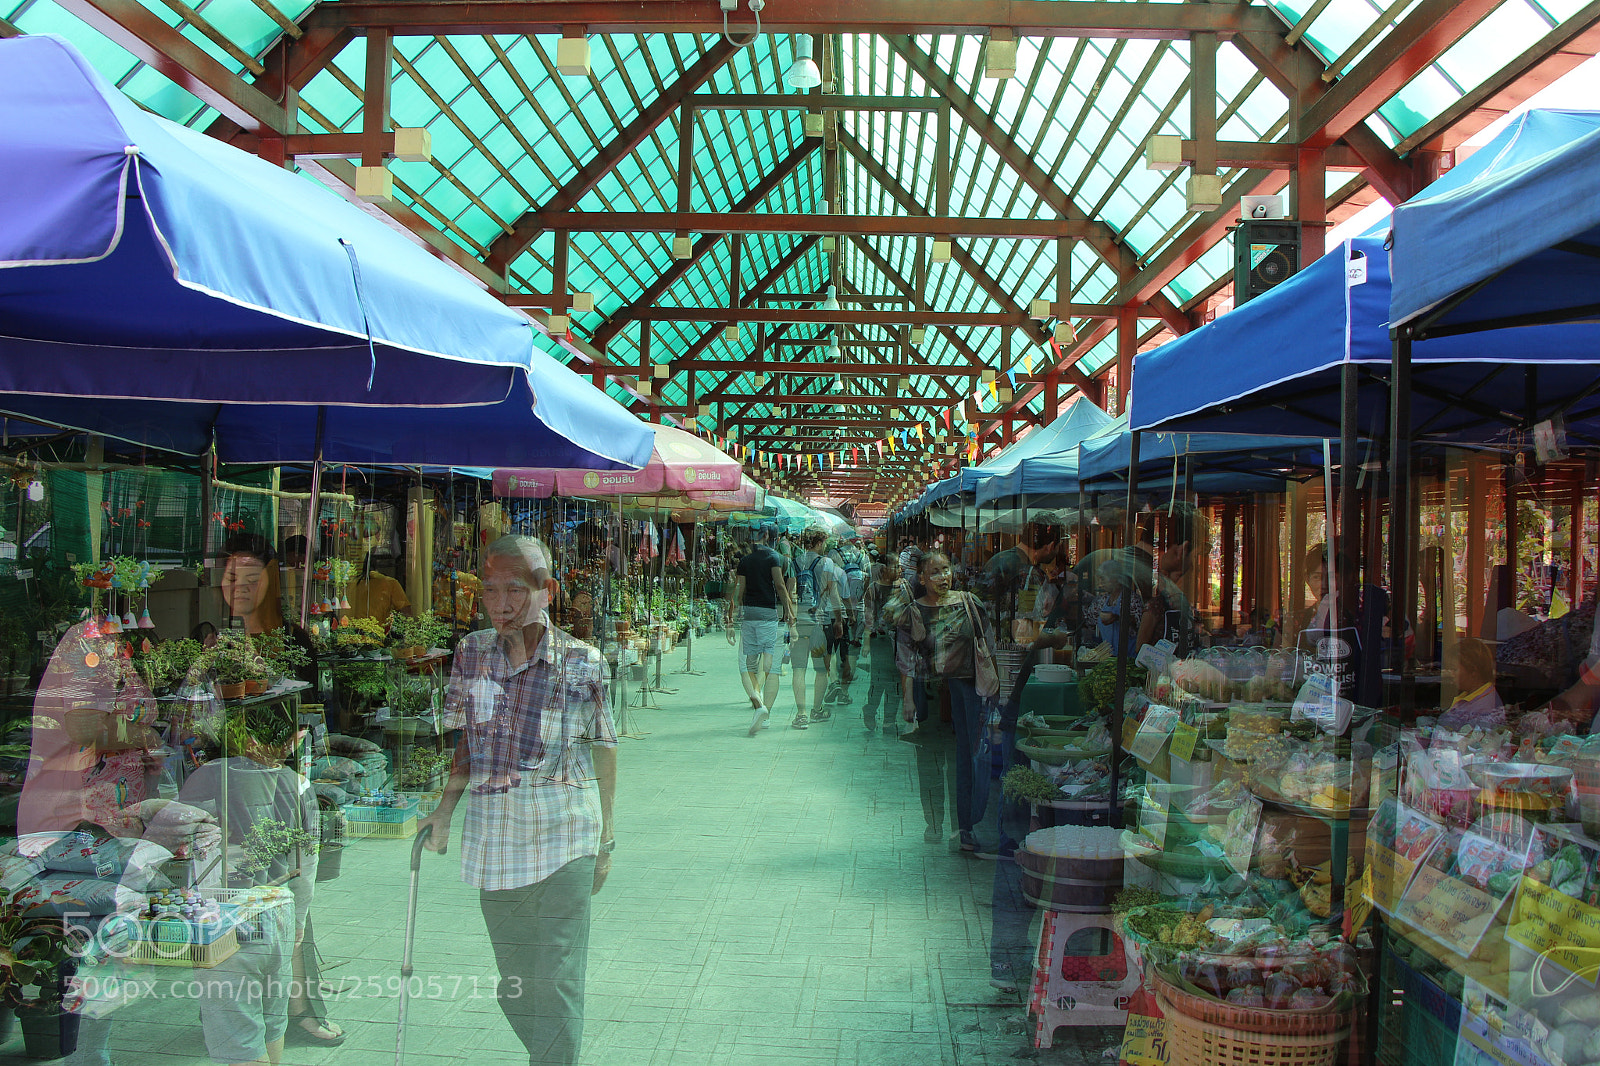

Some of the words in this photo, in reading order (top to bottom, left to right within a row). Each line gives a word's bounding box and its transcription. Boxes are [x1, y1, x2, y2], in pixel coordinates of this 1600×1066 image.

[602, 474, 635, 485] ออมสิน
[698, 471, 722, 481] ออมสิน
[1303, 660, 1349, 676] Power
